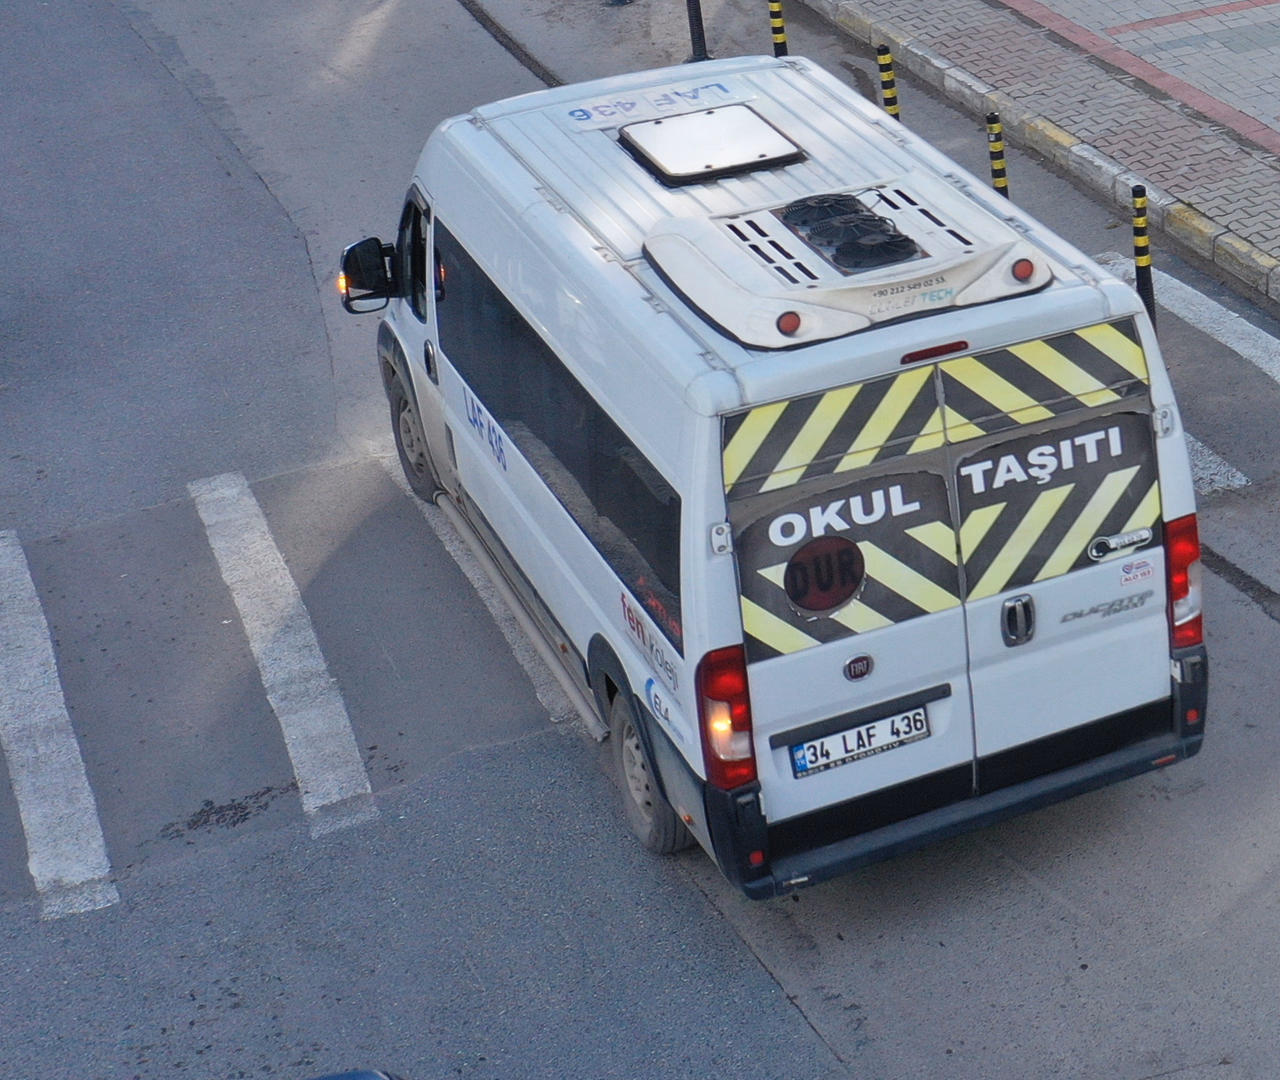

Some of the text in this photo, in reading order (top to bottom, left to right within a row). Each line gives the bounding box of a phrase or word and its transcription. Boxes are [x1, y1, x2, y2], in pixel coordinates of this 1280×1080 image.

[568, 83, 731, 121] LAF 436
[889, 286, 905, 295] 212
[463, 386, 507, 472] LAF 436
[768, 426, 1123, 547] OKUL TAŞITI
[789, 547, 862, 602] DUR
[620, 592, 646, 646] fen
[850, 660, 868, 676] FIAT
[653, 693, 670, 726] ELA
[806, 741, 831, 765] 34
[842, 725, 876, 754] LAF
[890, 712, 924, 738] 436
